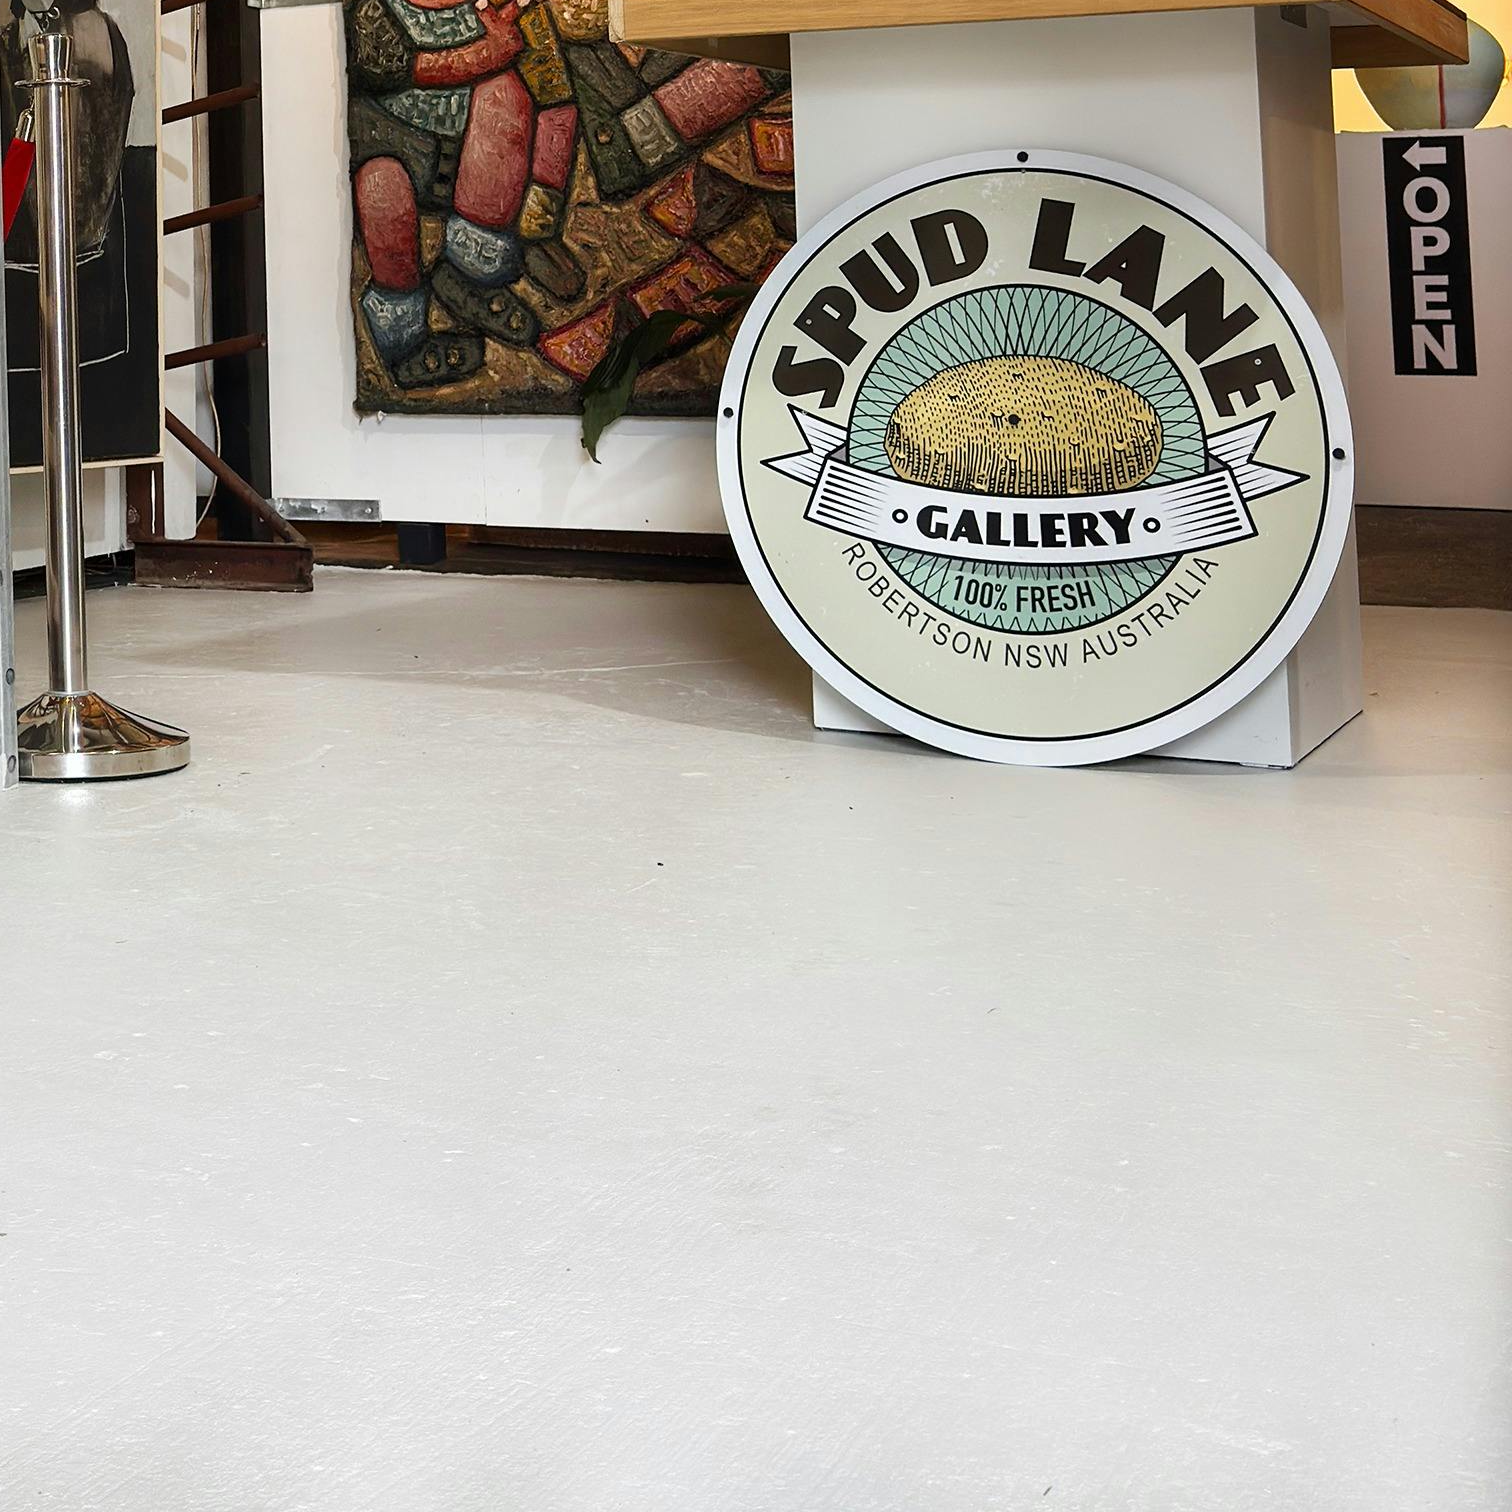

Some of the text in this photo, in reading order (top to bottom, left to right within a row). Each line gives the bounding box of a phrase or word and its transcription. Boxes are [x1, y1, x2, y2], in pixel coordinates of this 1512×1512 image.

[771, 197, 1296, 418] SPUD LANE
[1403, 176, 1458, 369] OPEN
[916, 504, 1136, 548] GALLERY
[841, 541, 1220, 669] ROBERTSON NSW AUSTRALIA
[952, 574, 1097, 614] 100% FRESH
